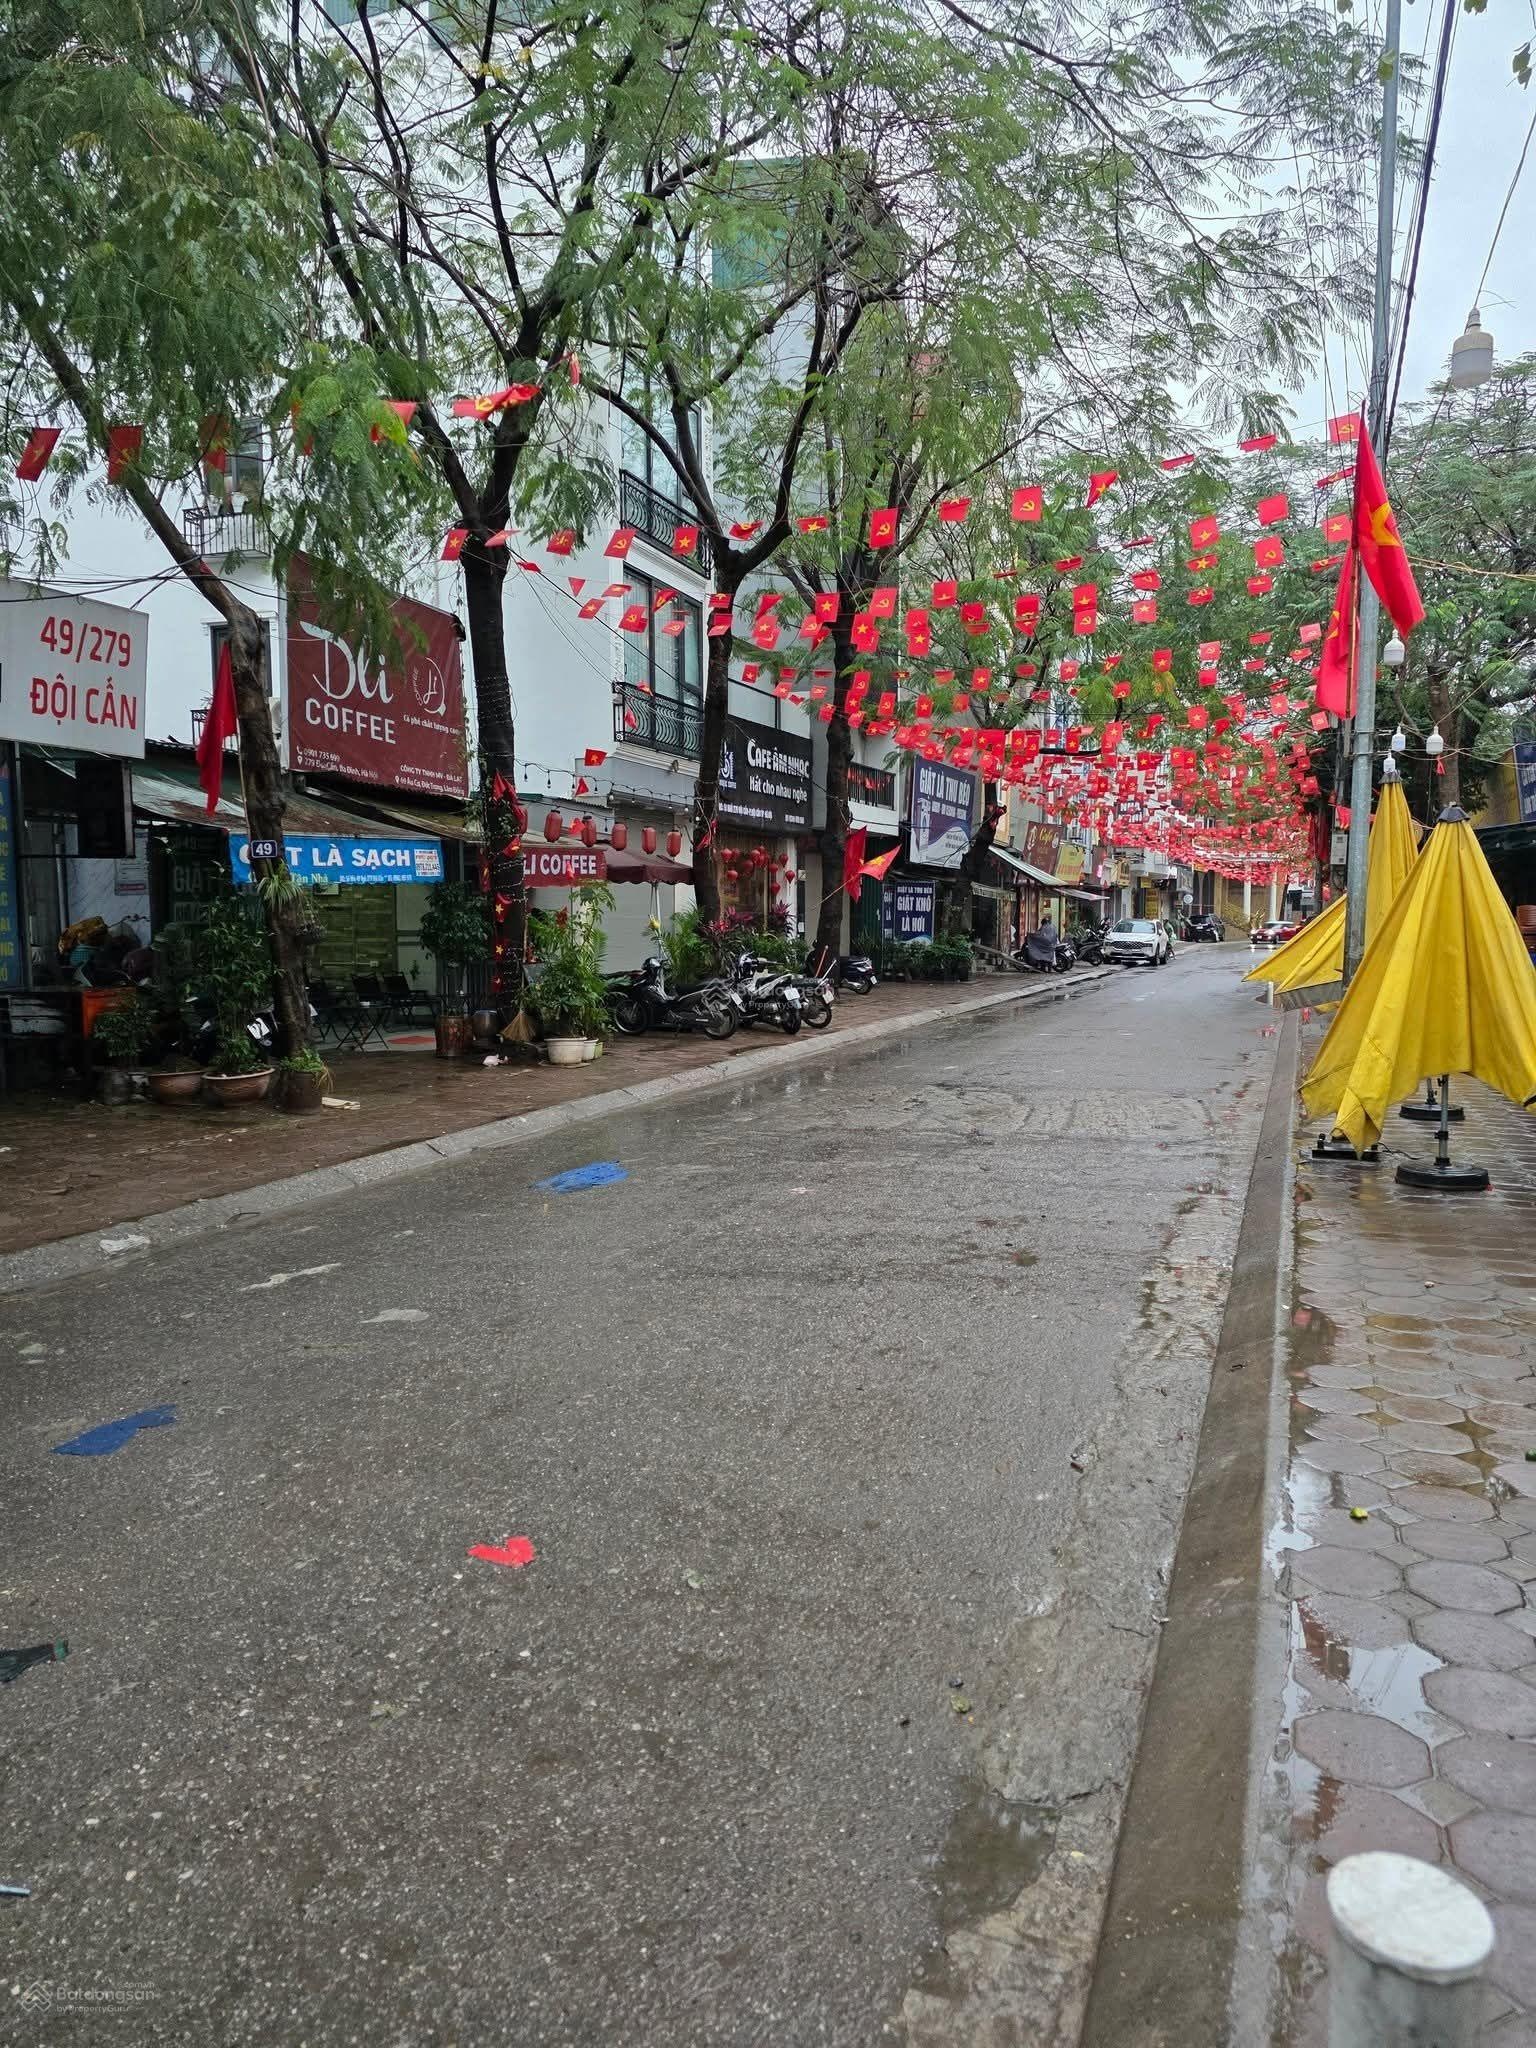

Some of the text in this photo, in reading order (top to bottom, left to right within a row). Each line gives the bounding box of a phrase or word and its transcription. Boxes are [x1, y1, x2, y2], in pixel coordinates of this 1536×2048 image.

[40, 616, 131, 667] 49/279
[30, 673, 137, 730] ĐỘI CẤN
[305, 698, 396, 744] COFFEE
[747, 738, 772, 770] CAFE
[749, 775, 761, 793] Hát
[762, 779, 775, 796] cho
[775, 782, 791, 799] nhau
[792, 787, 808, 804] nghe
[255, 843, 273, 856] 49
[312, 843, 343, 867] LÀ
[352, 848, 411, 870] SẠCH
[523, 853, 597, 875] LI COFFEE
